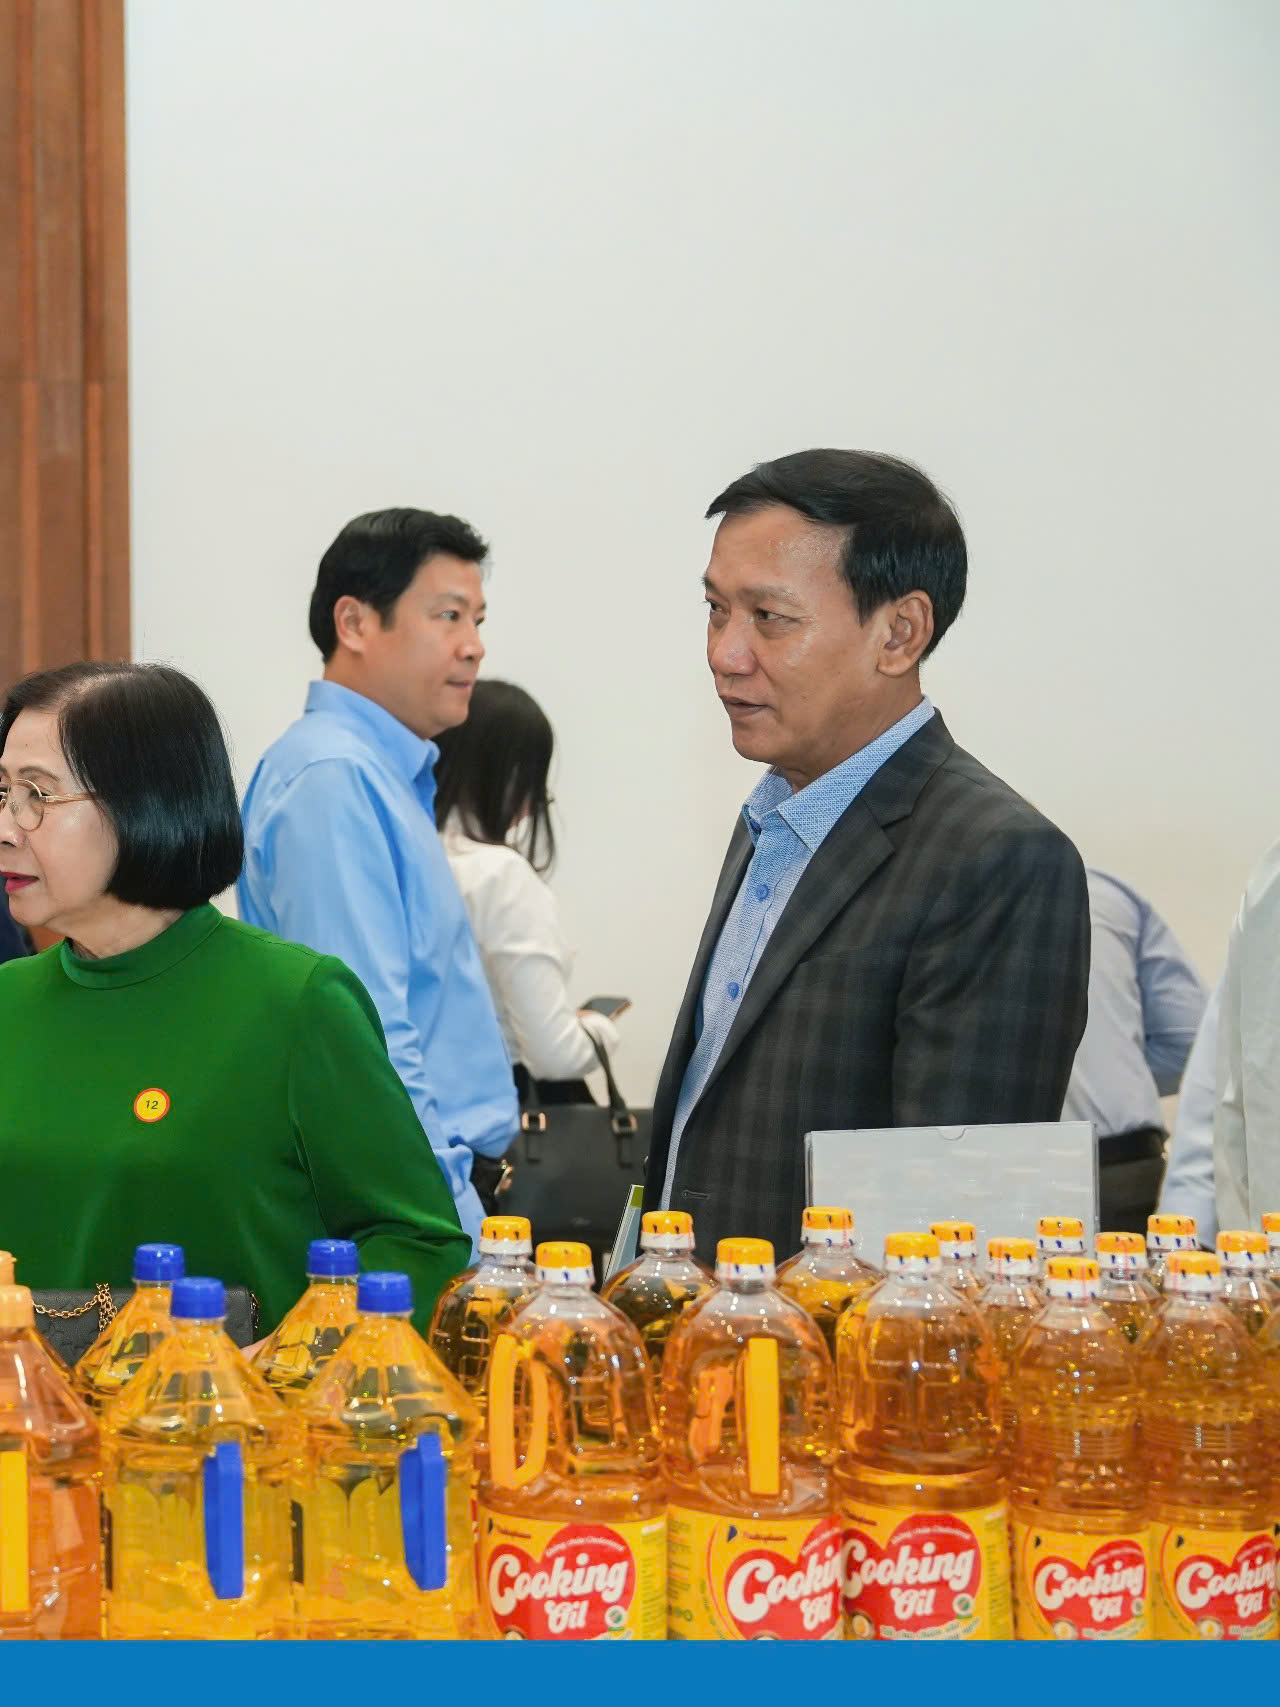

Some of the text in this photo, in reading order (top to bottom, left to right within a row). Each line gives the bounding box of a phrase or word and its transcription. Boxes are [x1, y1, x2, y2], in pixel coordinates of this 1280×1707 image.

[145, 1099, 159, 1110] 12
[489, 1552, 629, 1617] Cooking
[842, 1539, 975, 1599] Cooking
[1035, 1560, 1144, 1611] Cooking
[1176, 1555, 1276, 1609] Cookin
[544, 1600, 589, 1634] Oil
[800, 1592, 834, 1631] Oil
[889, 1587, 936, 1621] Oil
[1088, 1595, 1123, 1622] Oil
[1234, 1590, 1264, 1618] Oil
